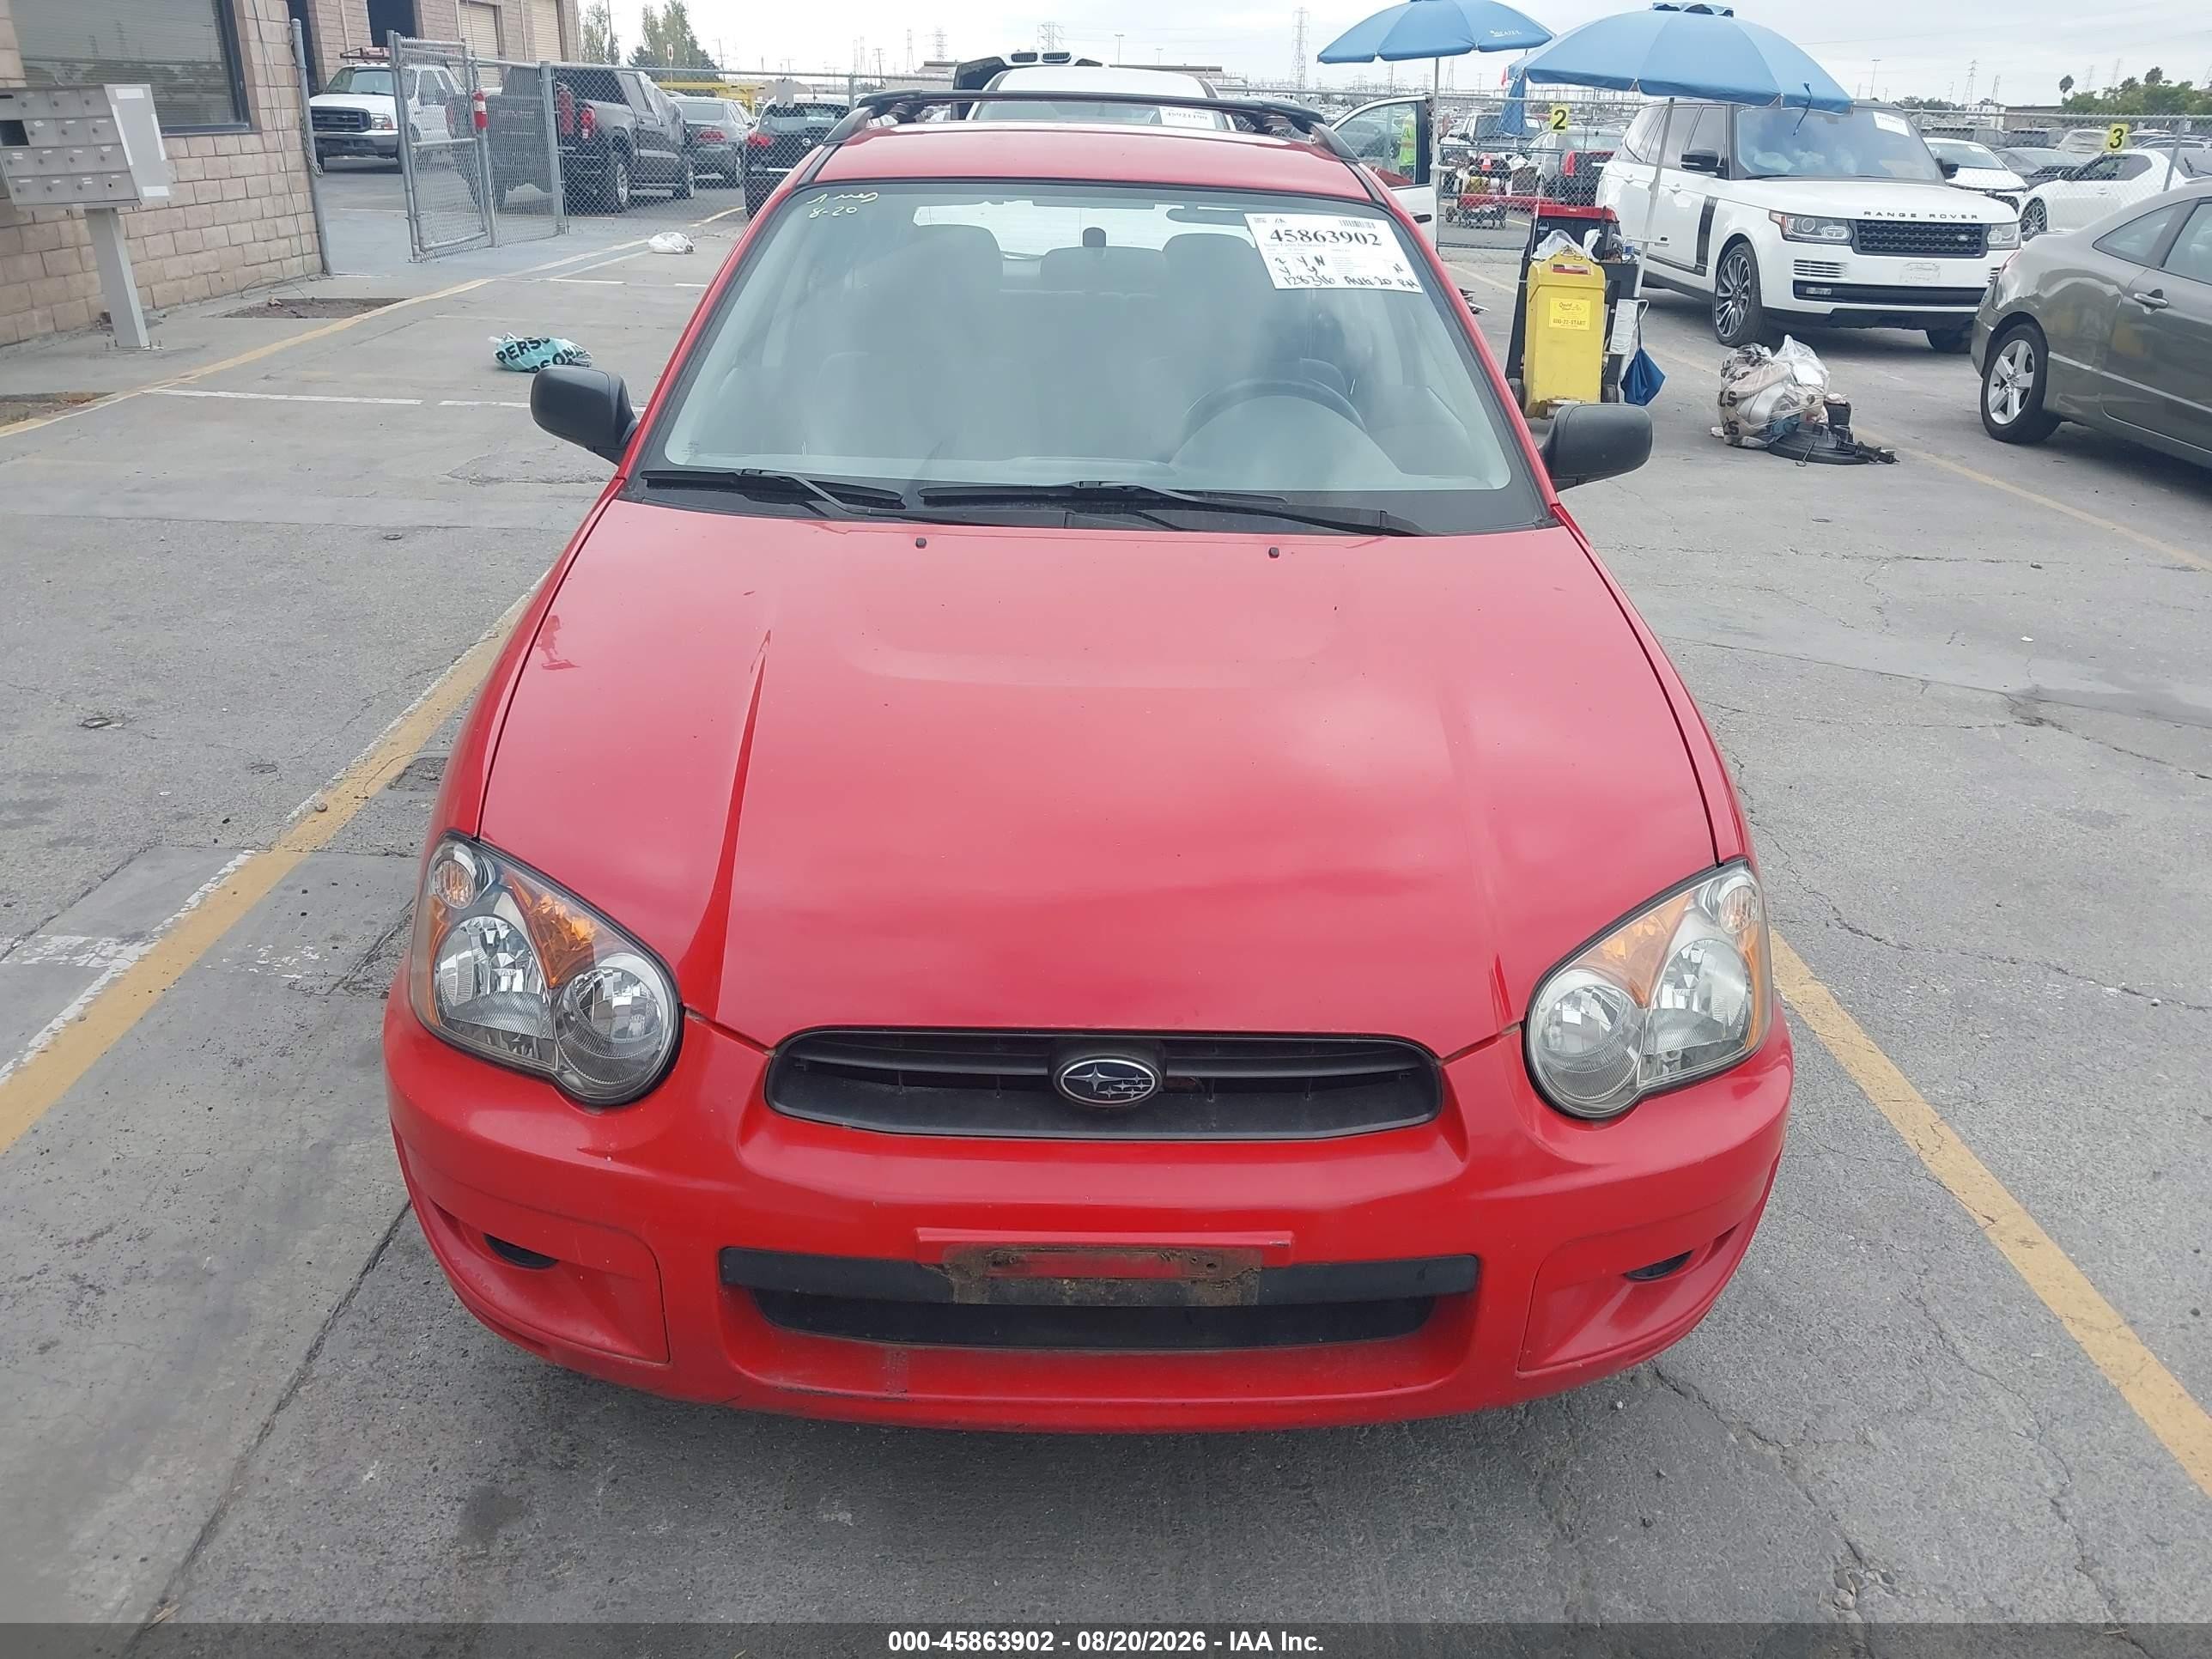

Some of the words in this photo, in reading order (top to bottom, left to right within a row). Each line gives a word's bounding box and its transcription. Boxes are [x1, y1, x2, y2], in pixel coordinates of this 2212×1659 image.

[1553, 109, 1567, 131] 2
[2109, 128, 2124, 149] 3
[1270, 228, 1382, 246] 45863902
